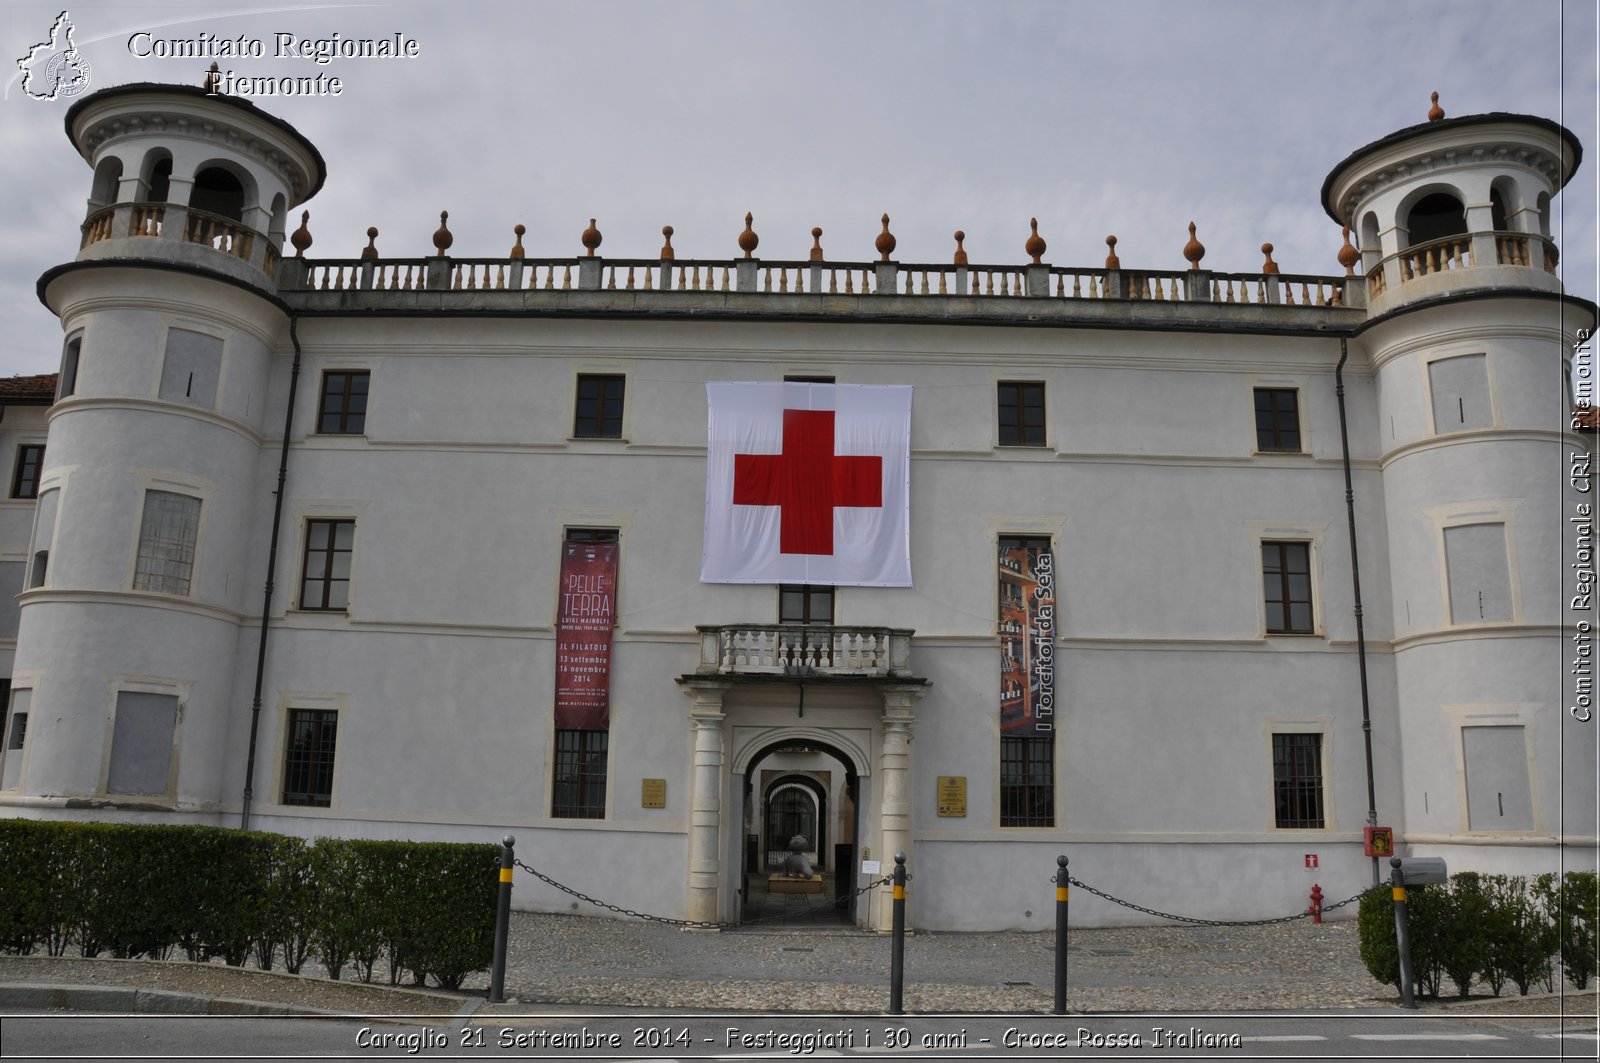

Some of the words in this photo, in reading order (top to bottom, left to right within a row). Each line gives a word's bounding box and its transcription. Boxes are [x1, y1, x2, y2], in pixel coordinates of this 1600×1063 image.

[569, 575, 605, 593] PELLE
[1034, 554, 1052, 599] Seta
[564, 594, 610, 616] TERRA
[1034, 606, 1052, 632] da
[1036, 638, 1054, 718] Torcitoi
